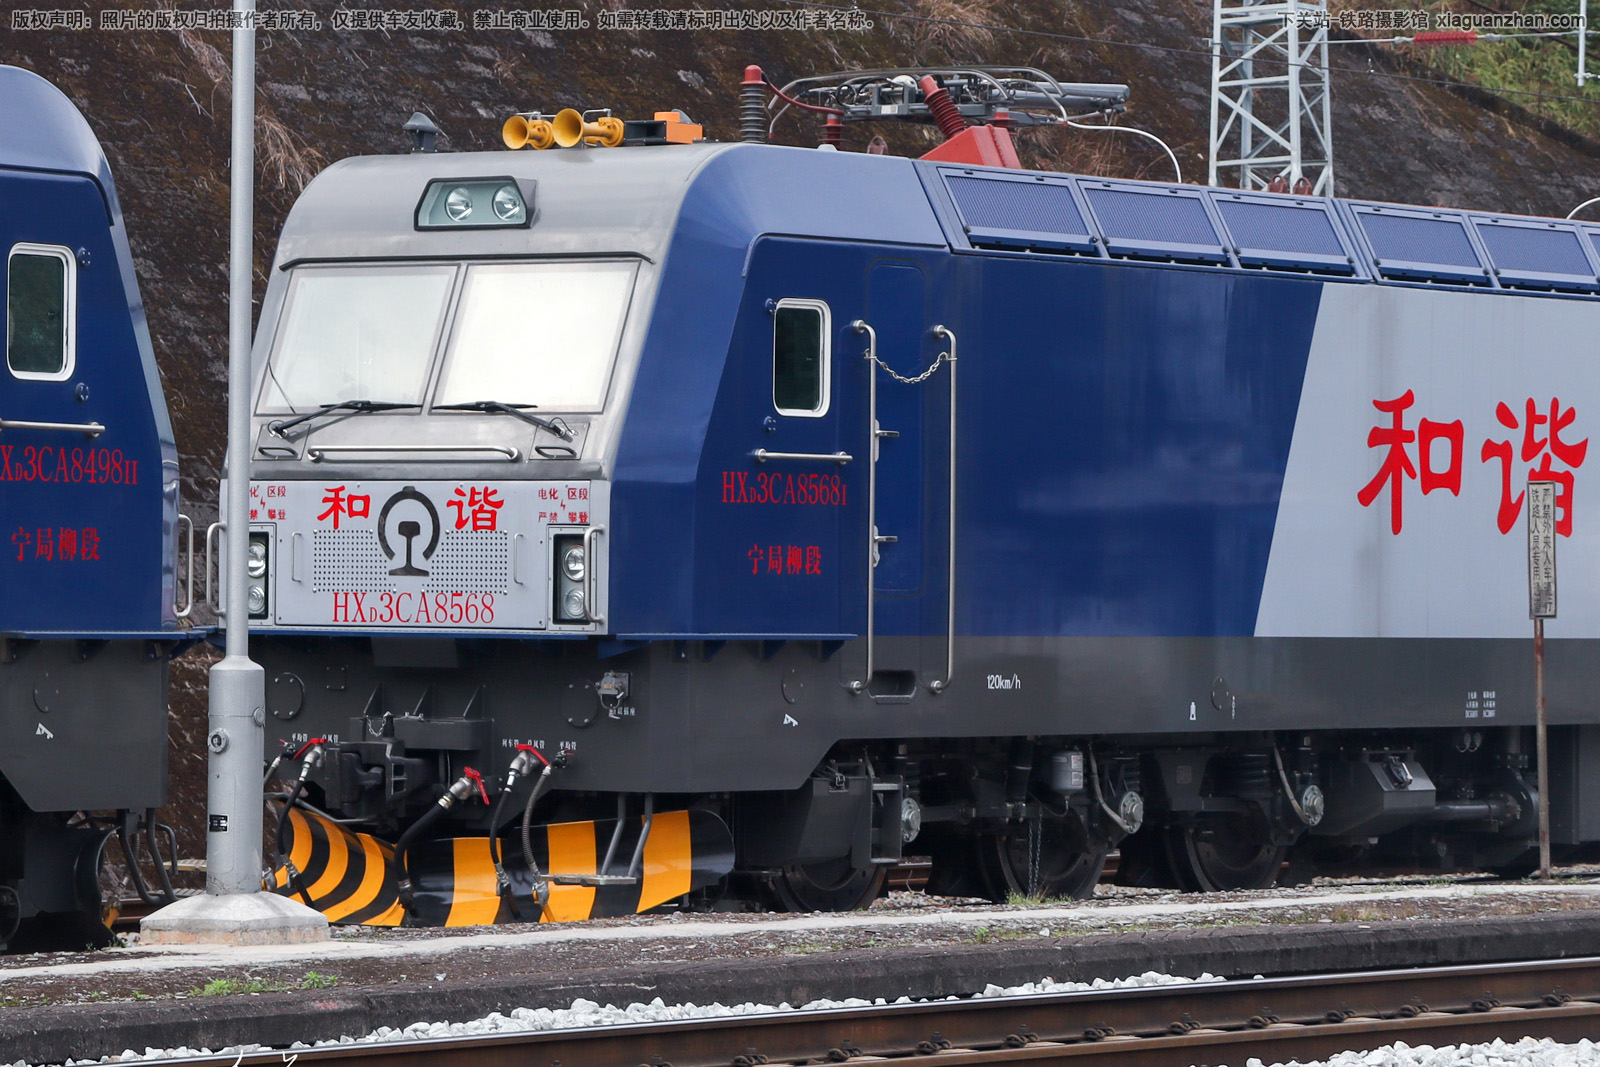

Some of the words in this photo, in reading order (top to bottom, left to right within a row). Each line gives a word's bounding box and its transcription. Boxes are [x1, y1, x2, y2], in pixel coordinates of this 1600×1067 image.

[1357, 389, 1589, 538] 和谐
[267, 485, 287, 498] 区段
[538, 488, 559, 500] 电化
[567, 487, 588, 500] 区段
[316, 485, 370, 531] 和
[446, 486, 505, 532] 谐
[538, 511, 559, 523] 严禁
[568, 511, 589, 524] 攀登
[11, 526, 101, 562] 宁局柳段
[747, 544, 822, 576] 宁局柳段
[987, 673, 1021, 690] 120km/h
